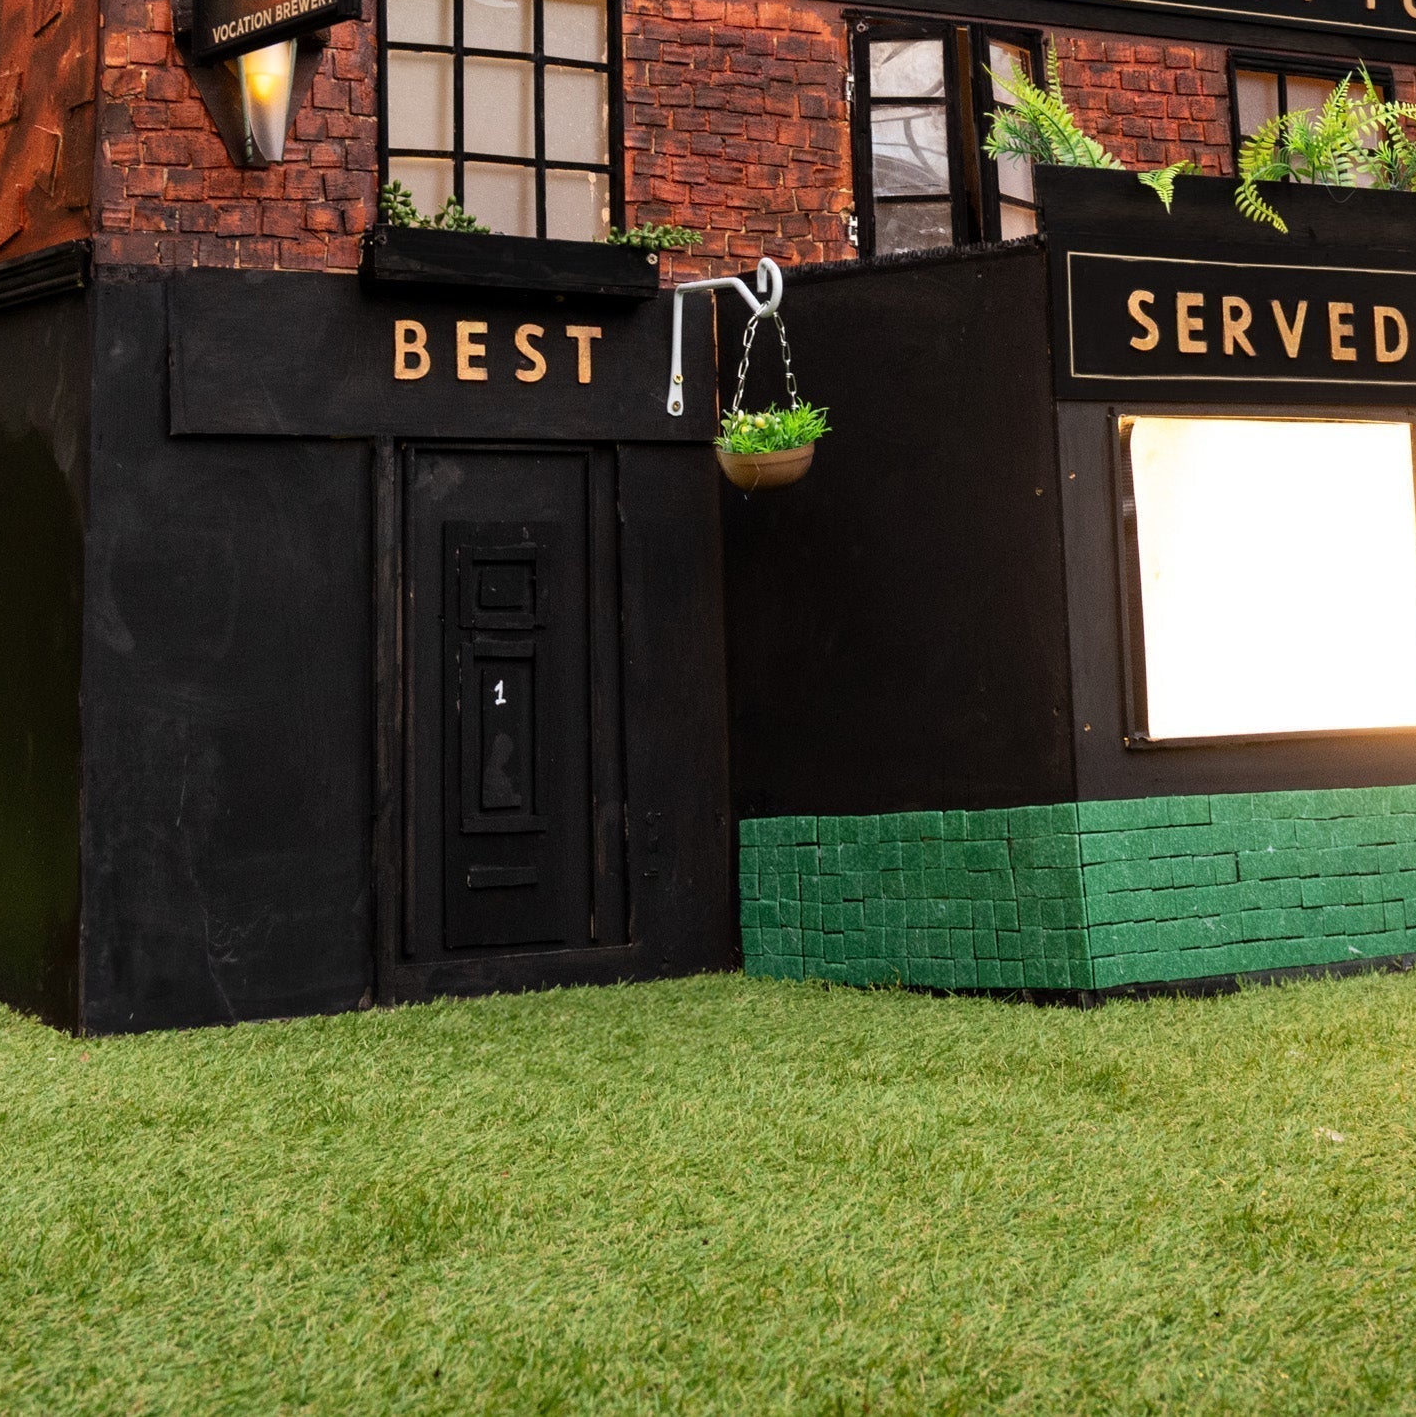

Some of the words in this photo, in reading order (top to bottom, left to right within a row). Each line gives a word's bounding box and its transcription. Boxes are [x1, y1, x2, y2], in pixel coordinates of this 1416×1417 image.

[212, 7, 273, 44] VOCATION
[393, 319, 603, 384] BEST
[1127, 289, 1410, 363] SERVED
[493, 679, 507, 706] 1
